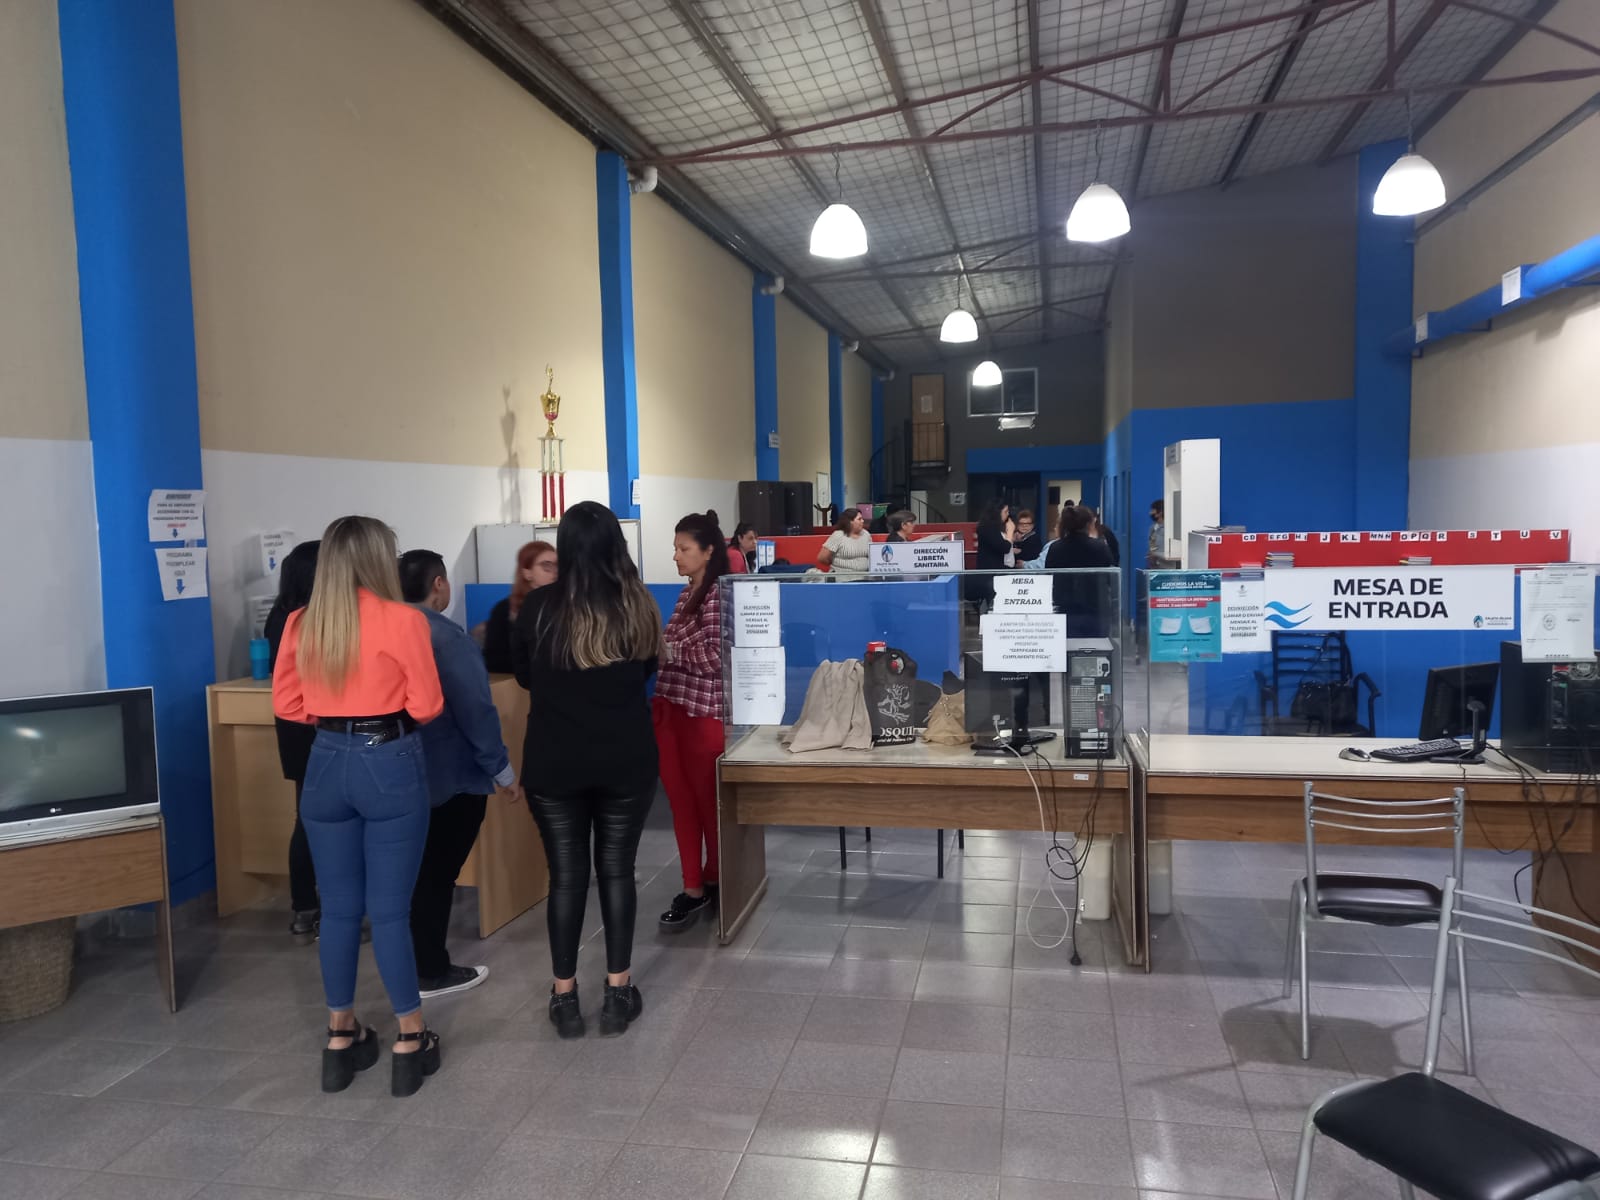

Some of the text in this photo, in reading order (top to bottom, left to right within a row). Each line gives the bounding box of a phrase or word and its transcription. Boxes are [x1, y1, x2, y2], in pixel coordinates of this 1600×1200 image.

[1334, 578, 1443, 596] MESA DE
[1329, 601, 1449, 619] ENTRADA
